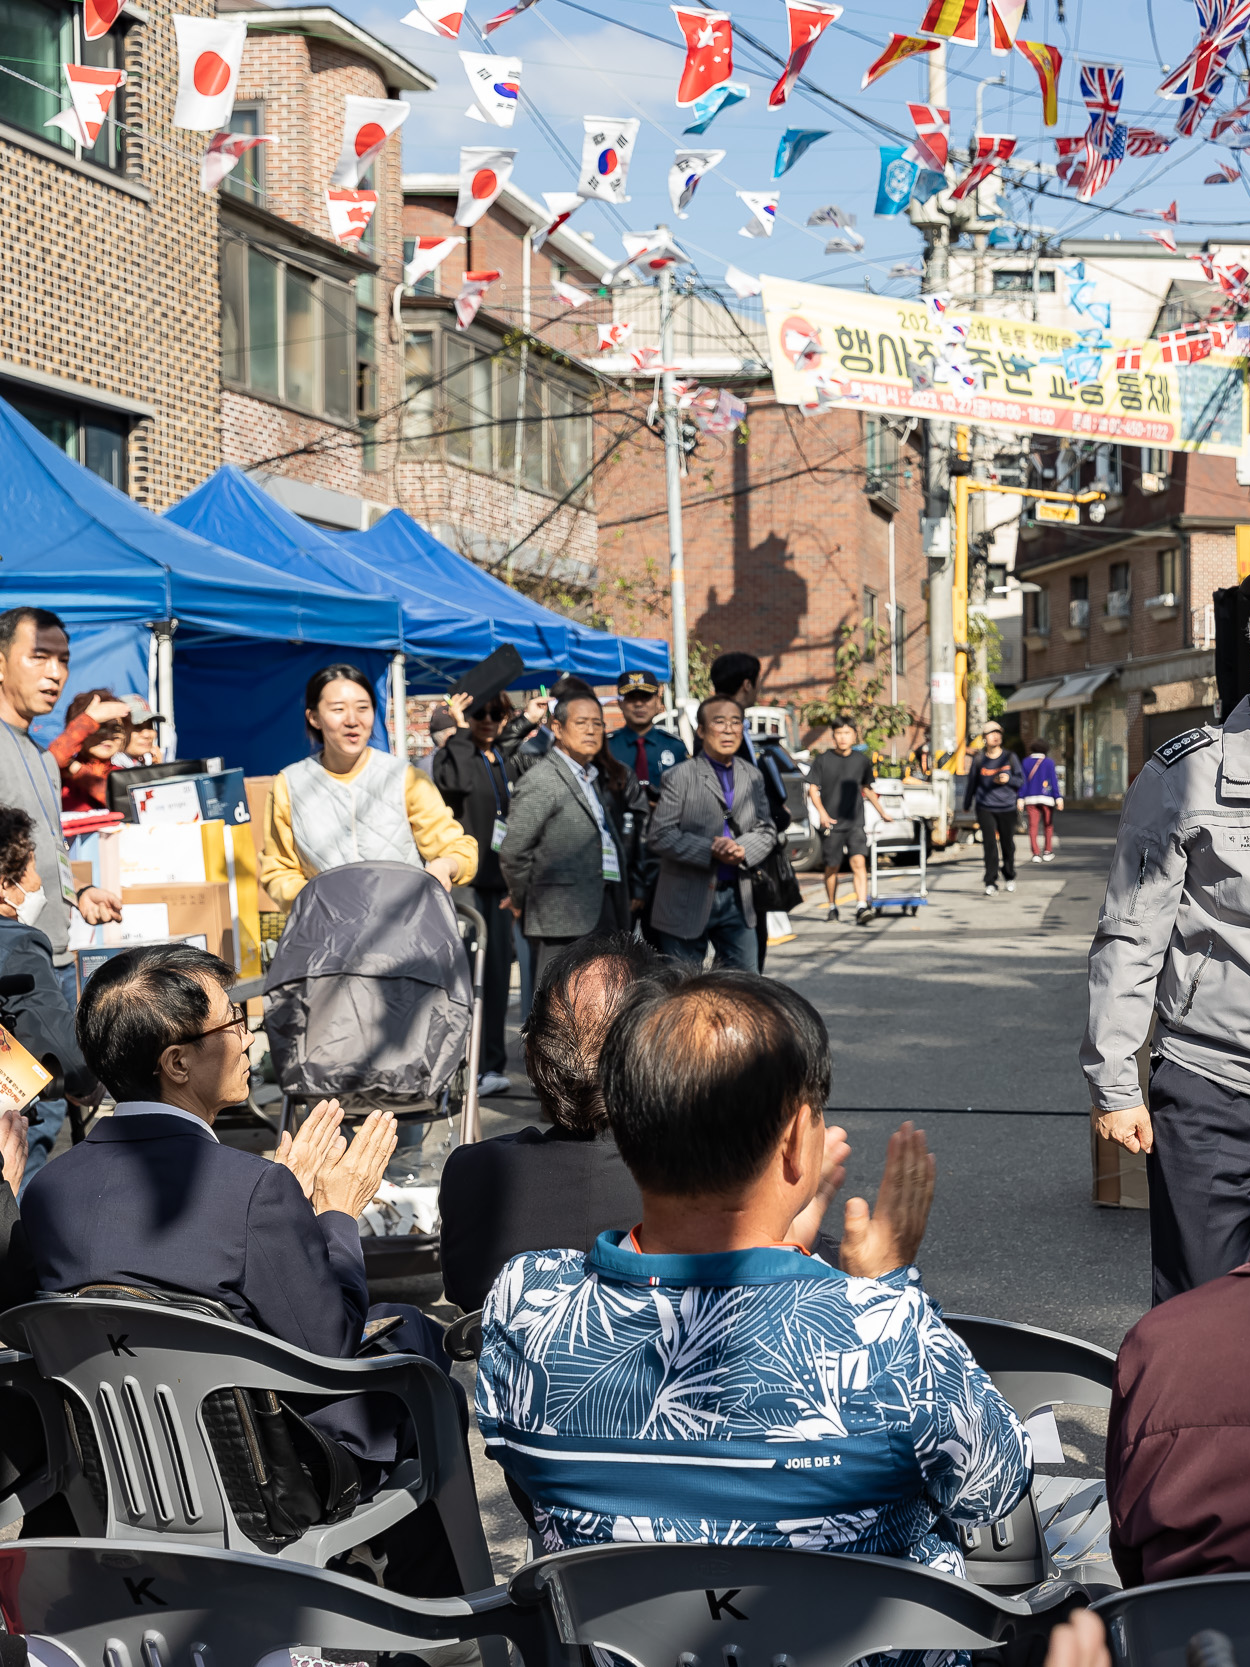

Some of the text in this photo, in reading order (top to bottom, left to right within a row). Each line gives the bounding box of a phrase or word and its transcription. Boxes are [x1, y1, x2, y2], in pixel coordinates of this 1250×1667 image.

[107, 1333, 138, 1358] K
[784, 1454, 842, 1469] JOIE DE X
[122, 1577, 168, 1606] K
[705, 1589, 750, 1620] K
